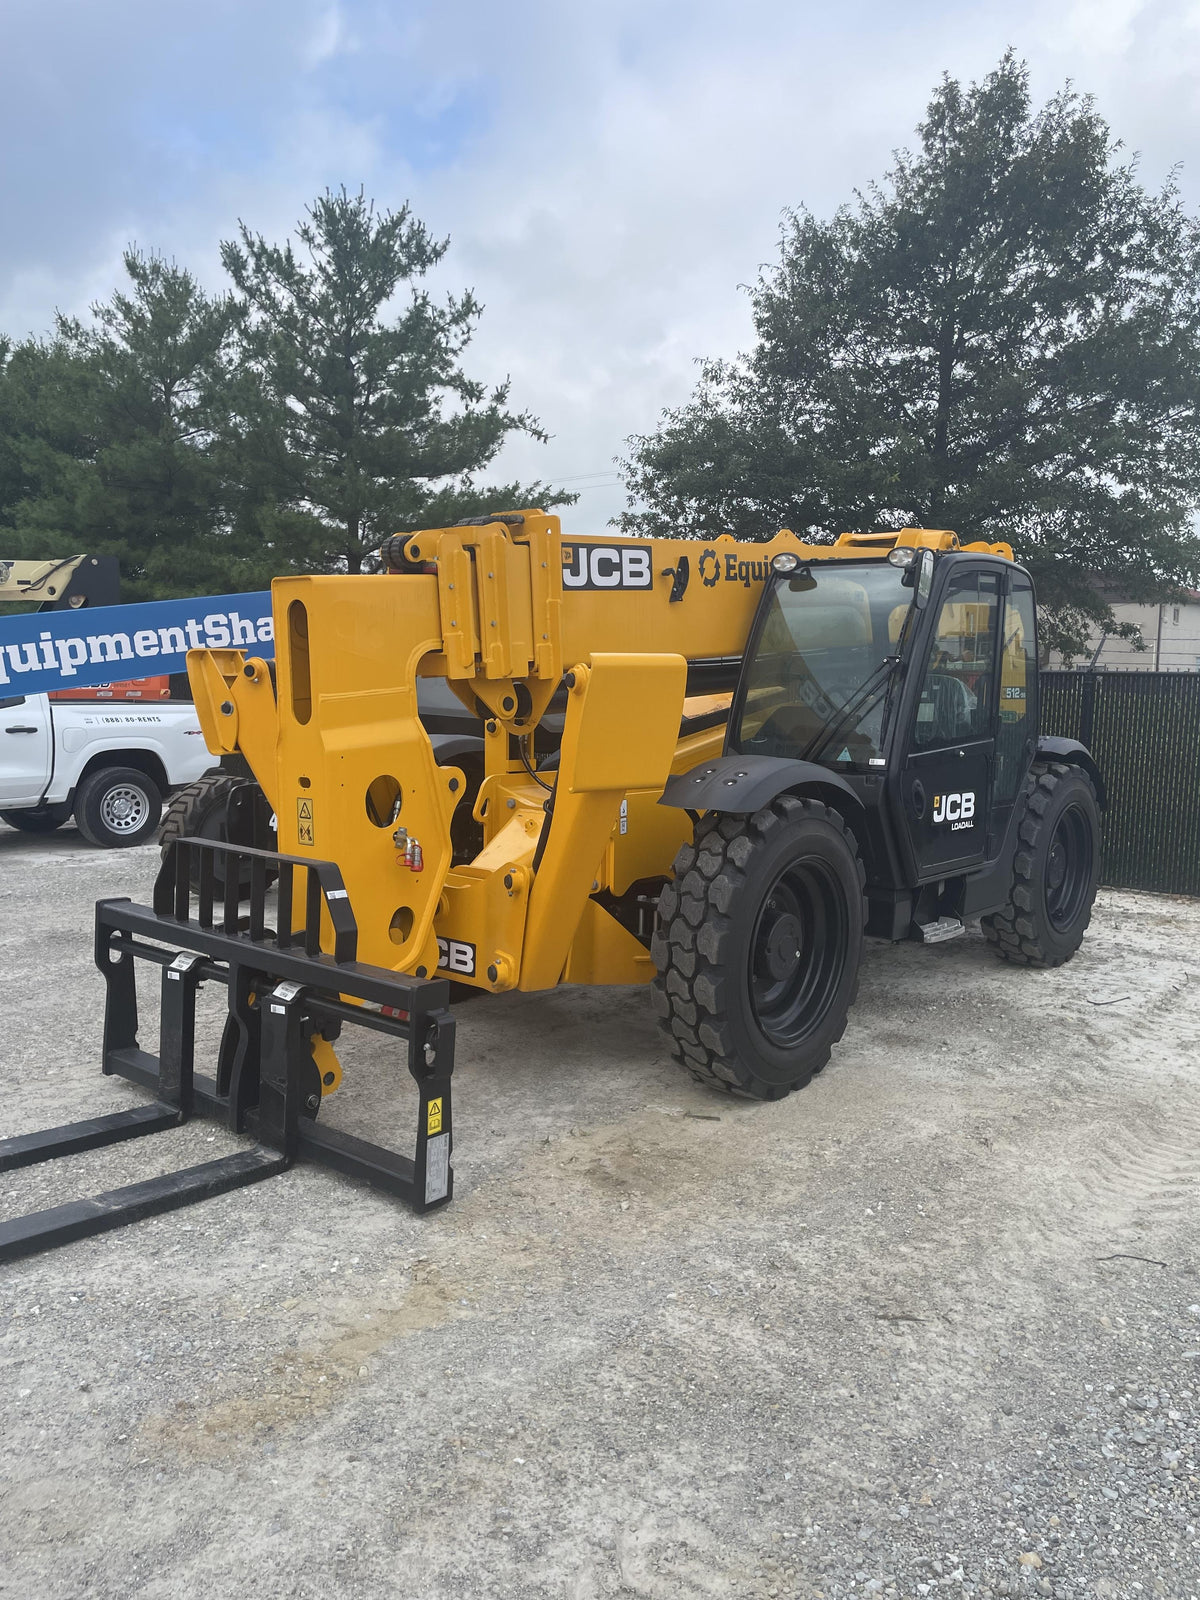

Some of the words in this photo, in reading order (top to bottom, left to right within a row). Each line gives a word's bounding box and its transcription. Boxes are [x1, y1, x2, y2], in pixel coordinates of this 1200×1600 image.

[562, 548, 651, 587] JCB
[102, 716, 123, 724] (888)
[933, 792, 975, 823] JCB
[951, 820, 975, 831] LOADALL
